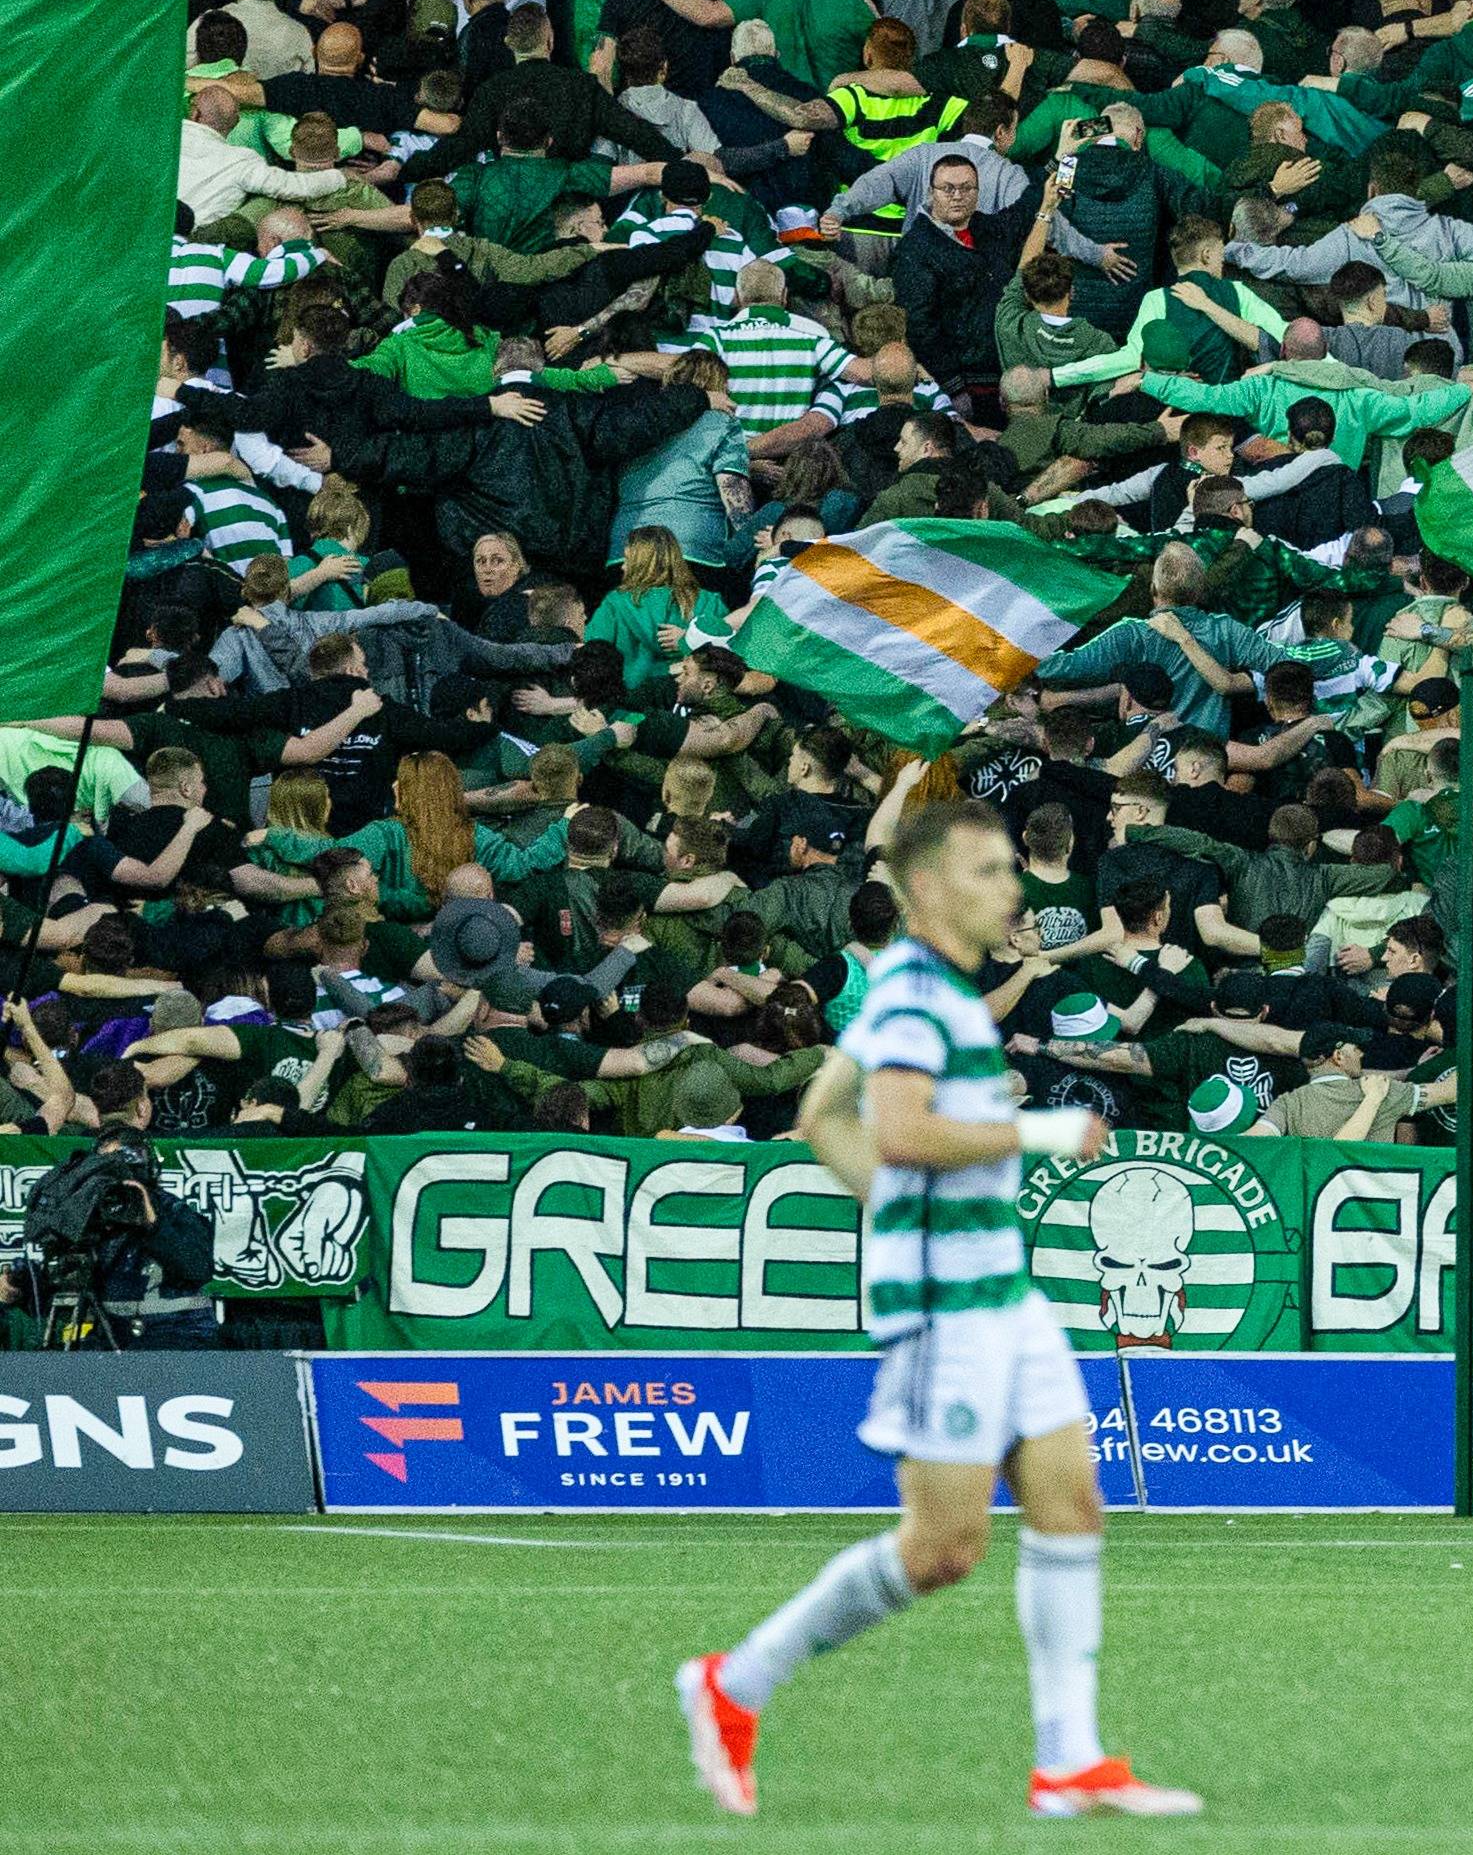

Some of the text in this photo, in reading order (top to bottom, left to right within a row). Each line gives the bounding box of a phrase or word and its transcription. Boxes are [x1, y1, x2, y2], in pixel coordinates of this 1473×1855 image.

[1142, 1131, 1278, 1230] BRIGADE
[388, 1148, 862, 1332] GREE
[552, 1381, 697, 1406] JAMES
[500, 1410, 751, 1458] FREW
[1149, 1407, 1282, 1435] 468113
[560, 1472, 709, 1487] SINCE 1911
